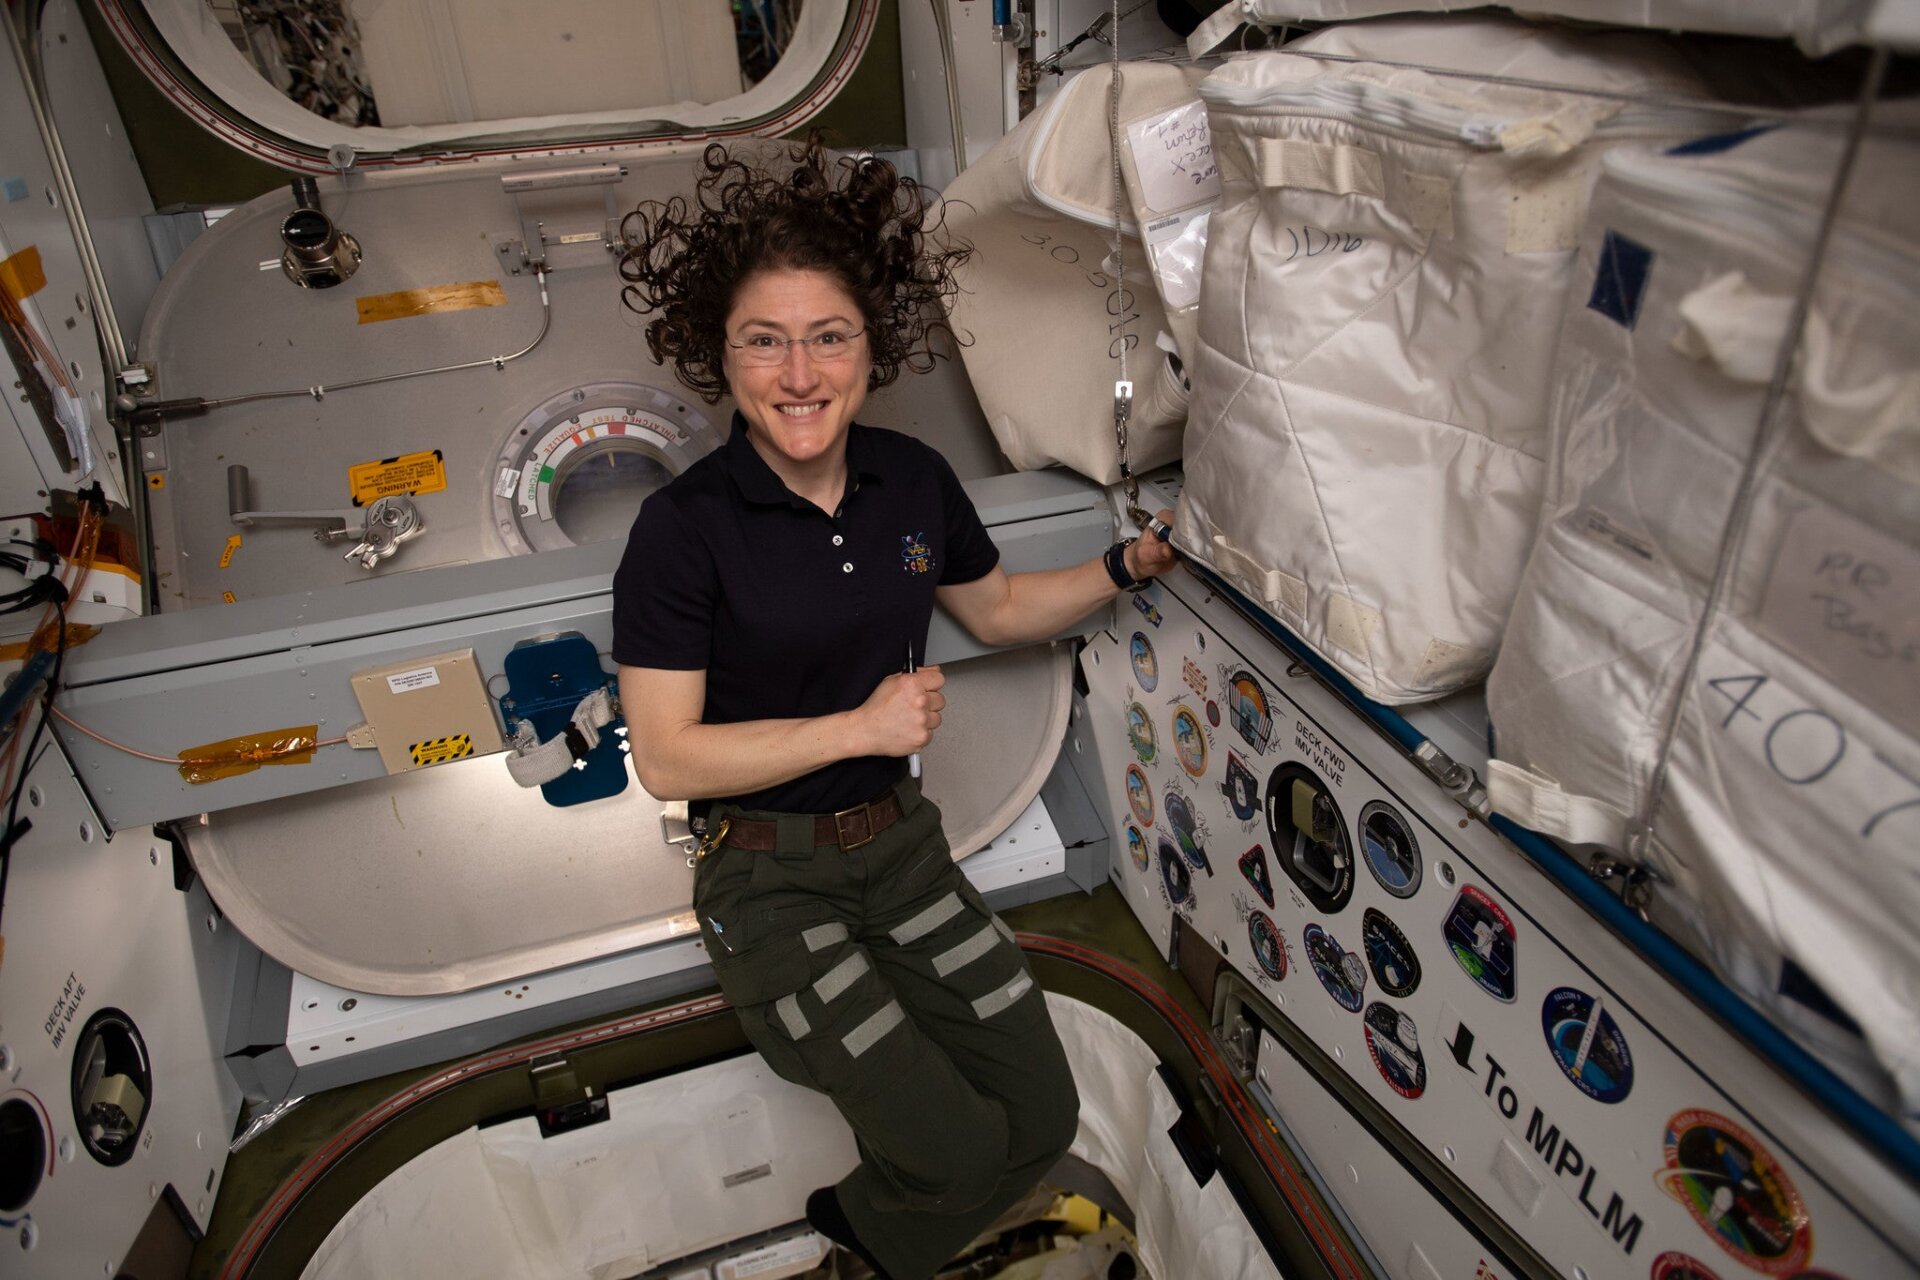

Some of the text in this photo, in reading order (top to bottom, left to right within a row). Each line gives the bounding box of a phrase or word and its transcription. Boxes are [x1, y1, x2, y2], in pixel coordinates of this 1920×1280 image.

[543, 423, 584, 455] EQUALIZE
[592, 414, 615, 424] TEST
[621, 415, 677, 442] UNLATCHED
[376, 480, 422, 494] WARNING
[527, 462, 543, 502] LATCHED
[1294, 736, 1343, 787] IMV VALVE
[1295, 720, 1346, 772] DECK FWD
[44, 971, 78, 1035] DECK AFT
[51, 983, 87, 1049] IMV VALVE
[1554, 991, 1576, 1001] FALCON
[1552, 1048, 1577, 1080] SPACEX
[1610, 1028, 1630, 1068] DRAGON
[1484, 1052, 1644, 1256] To MPLM
